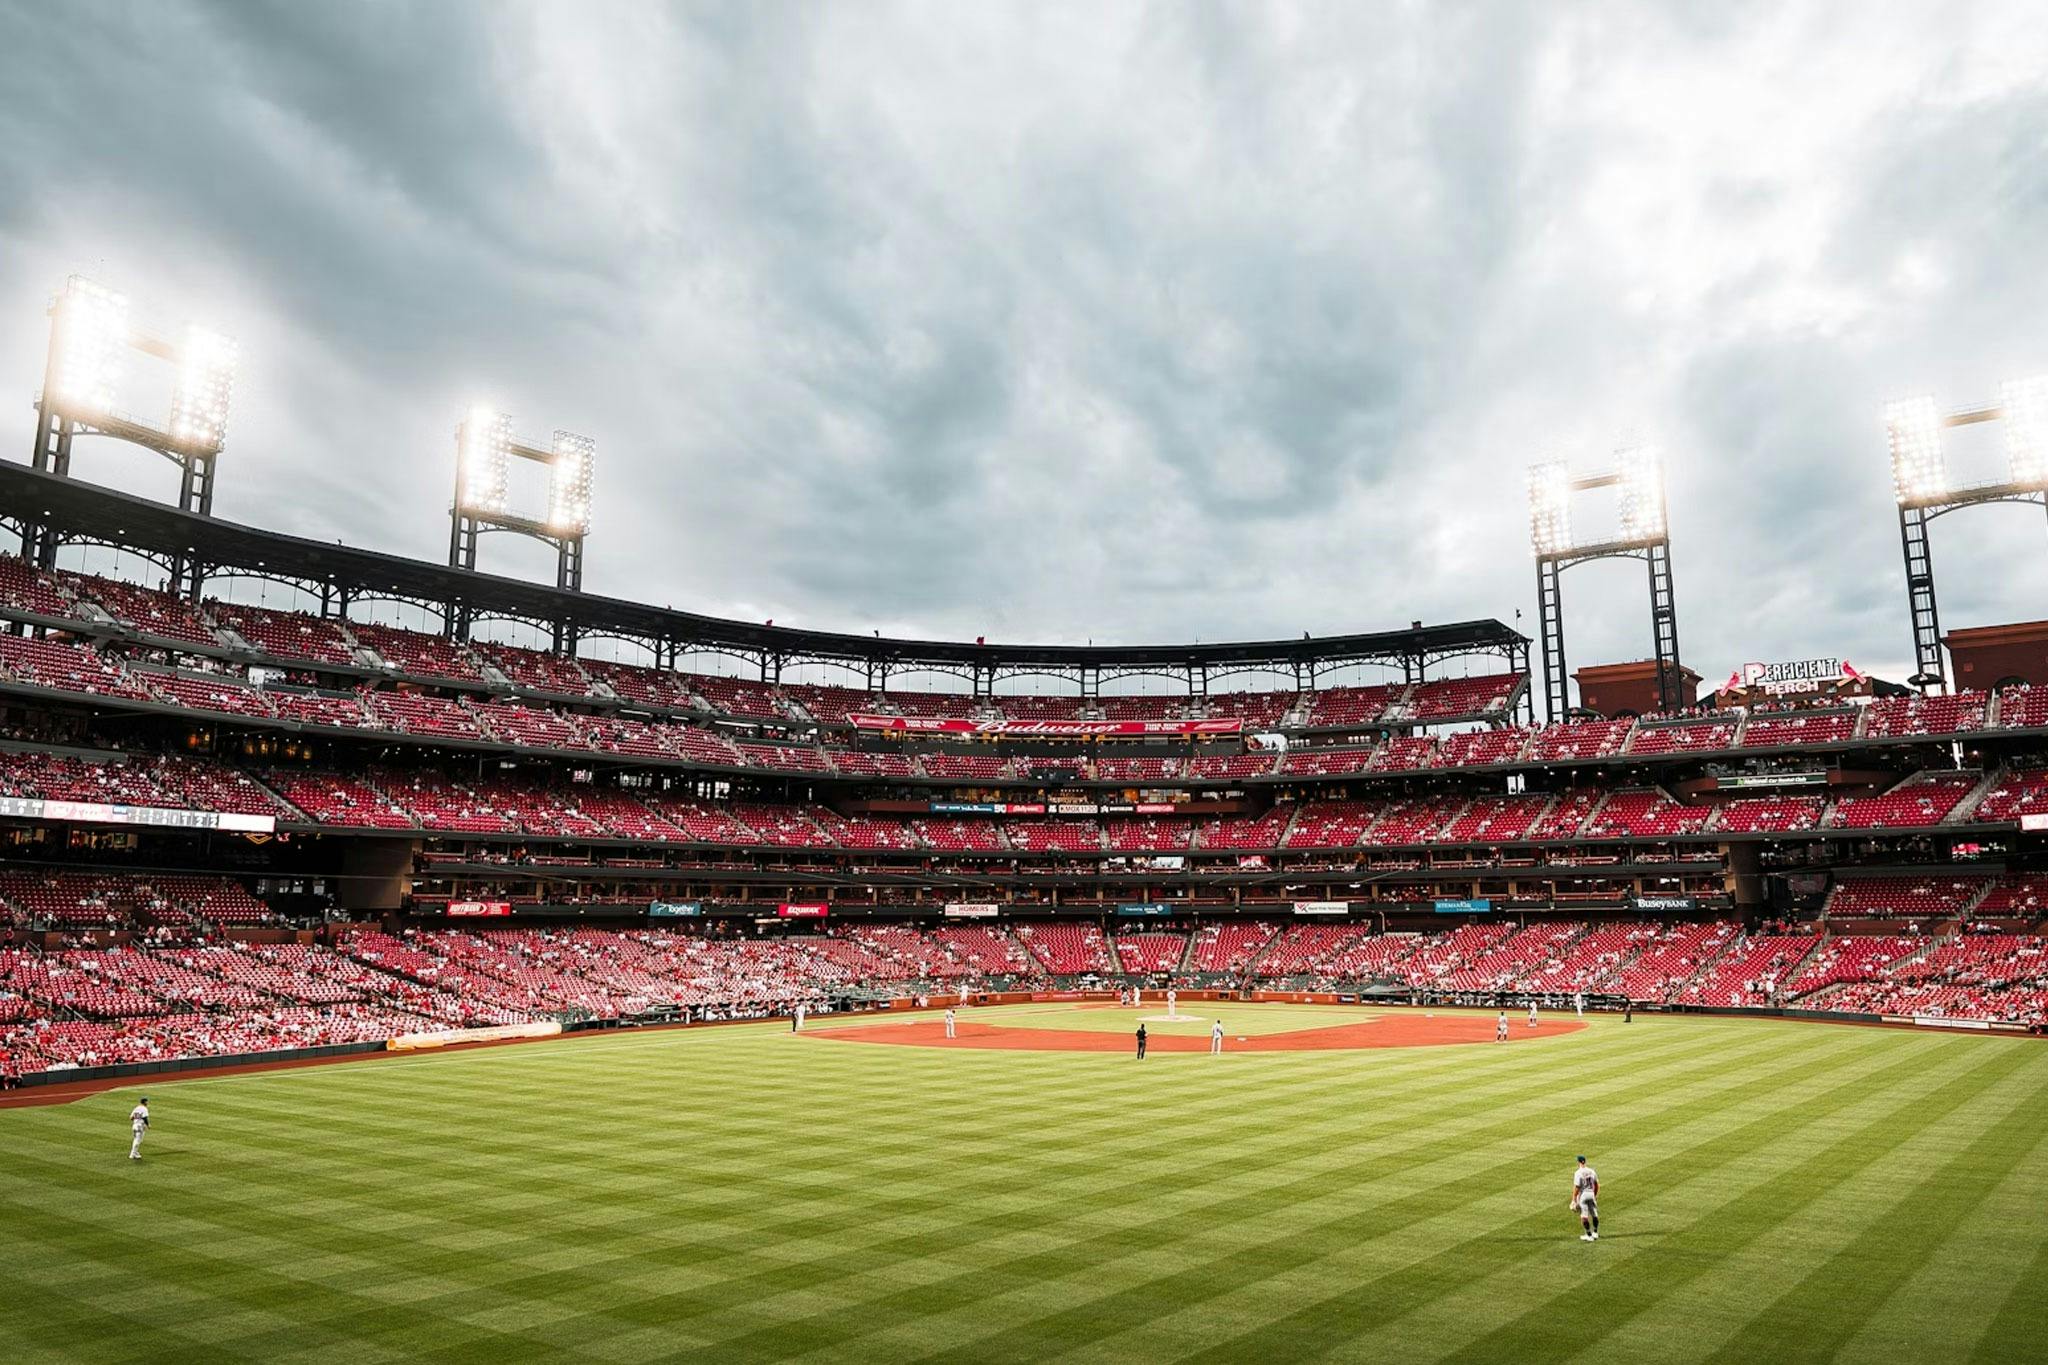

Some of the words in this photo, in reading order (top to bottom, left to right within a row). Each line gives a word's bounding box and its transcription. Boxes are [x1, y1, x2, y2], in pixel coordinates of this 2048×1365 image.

[1744, 658, 1837, 686] PERFICIENT
[1765, 681, 1819, 695] PERCH
[969, 719, 1121, 733] Budweiser
[668, 904, 694, 914] Together
